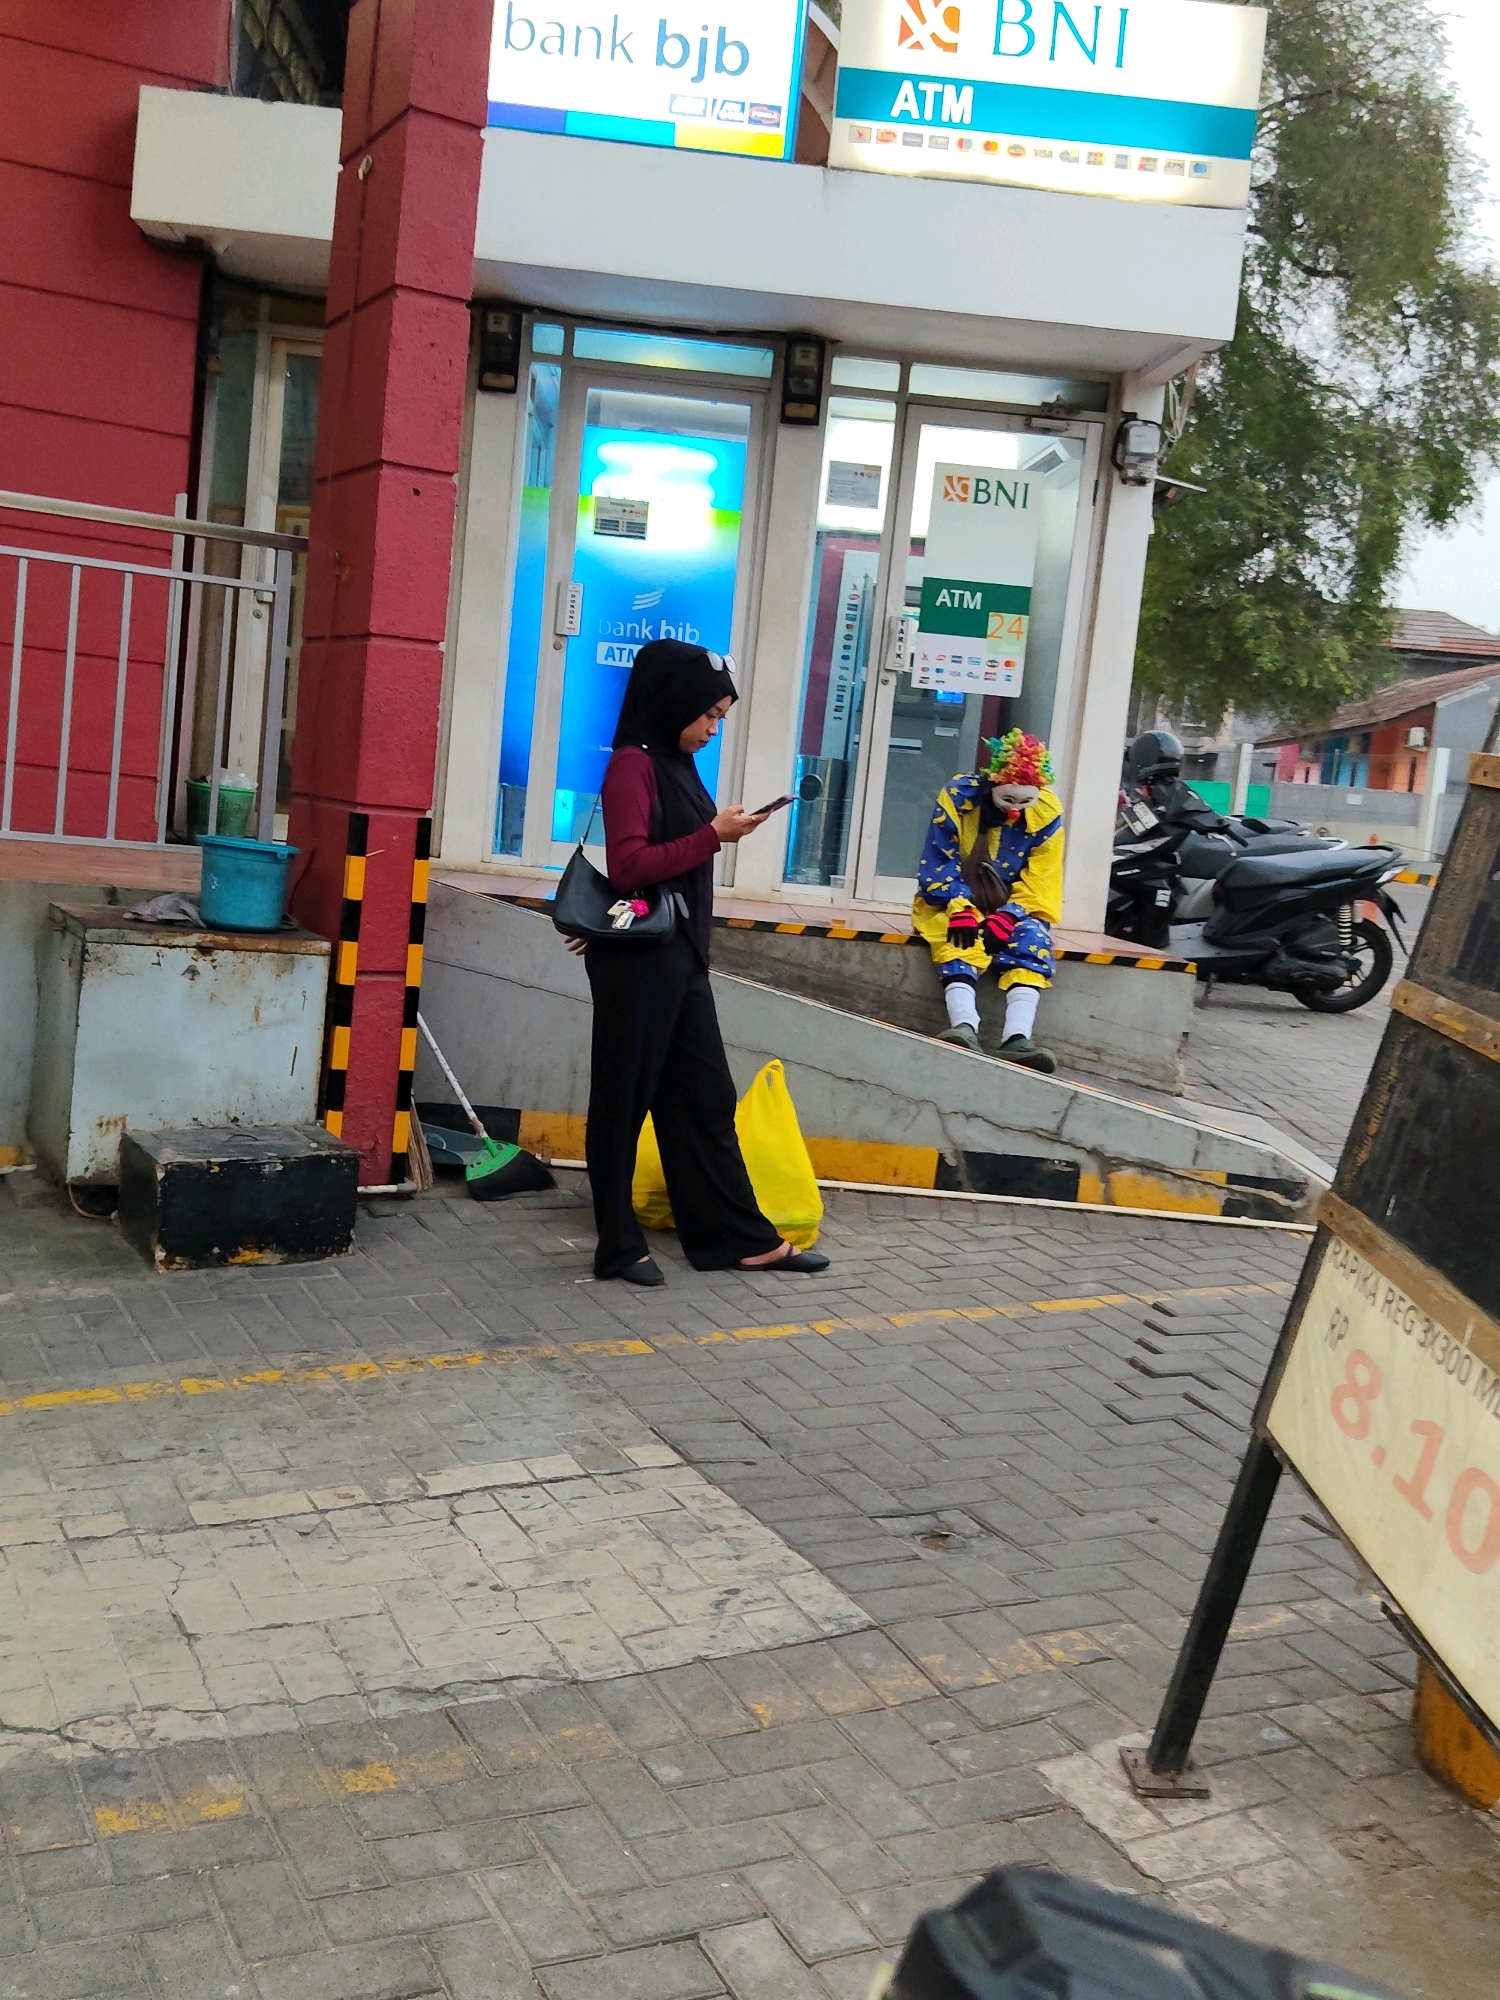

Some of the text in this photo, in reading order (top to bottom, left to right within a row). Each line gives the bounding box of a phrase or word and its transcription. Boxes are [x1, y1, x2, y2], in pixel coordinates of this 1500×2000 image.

[504, 1, 750, 84] bank bjb
[992, 0, 1130, 69] BNI
[890, 79, 975, 125] ATM
[973, 477, 1031, 510] BNI
[935, 589, 983, 611] ATM
[599, 617, 654, 641] bank
[895, 619, 907, 660] TARIK
[988, 613, 1024, 641] 24
[1322, 1305, 1350, 1351] RP
[1326, 1237, 1380, 1307] RAPIKA
[1380, 1286, 1419, 1336] REG
[1416, 1316, 1473, 1386] 3X300
